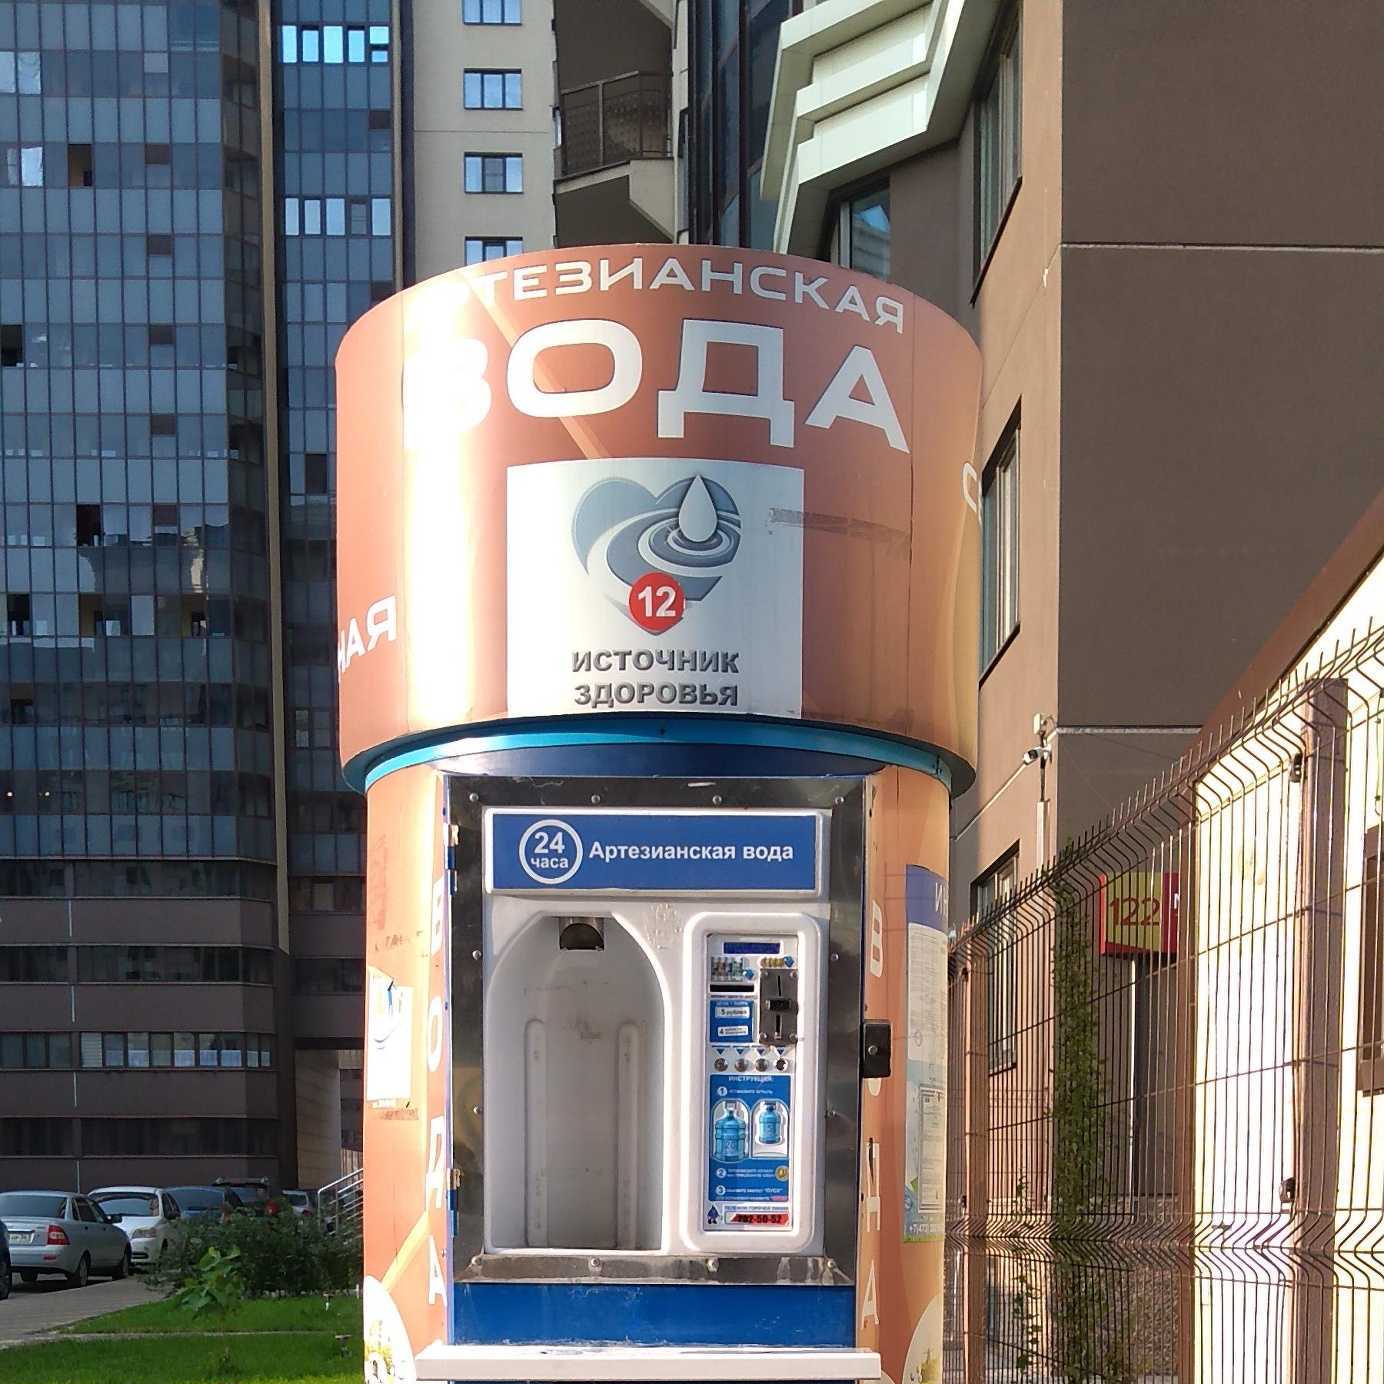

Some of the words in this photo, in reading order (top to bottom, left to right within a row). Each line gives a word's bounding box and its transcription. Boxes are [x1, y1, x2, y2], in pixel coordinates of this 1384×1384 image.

[456, 258, 905, 335] ТЕЗИАНСКАЯ
[402, 317, 911, 455] ВОДА
[637, 585, 677, 618] 12
[572, 649, 740, 674] ИСТОЧНИК
[573, 682, 739, 709] ЗДОРОВЬЯ
[533, 831, 565, 855] 24
[588, 841, 737, 863] Артезианская
[742, 844, 794, 862] вода
[530, 855, 569, 870] часа
[1109, 895, 1160, 927] 122
[861, 898, 883, 1330] ВДА
